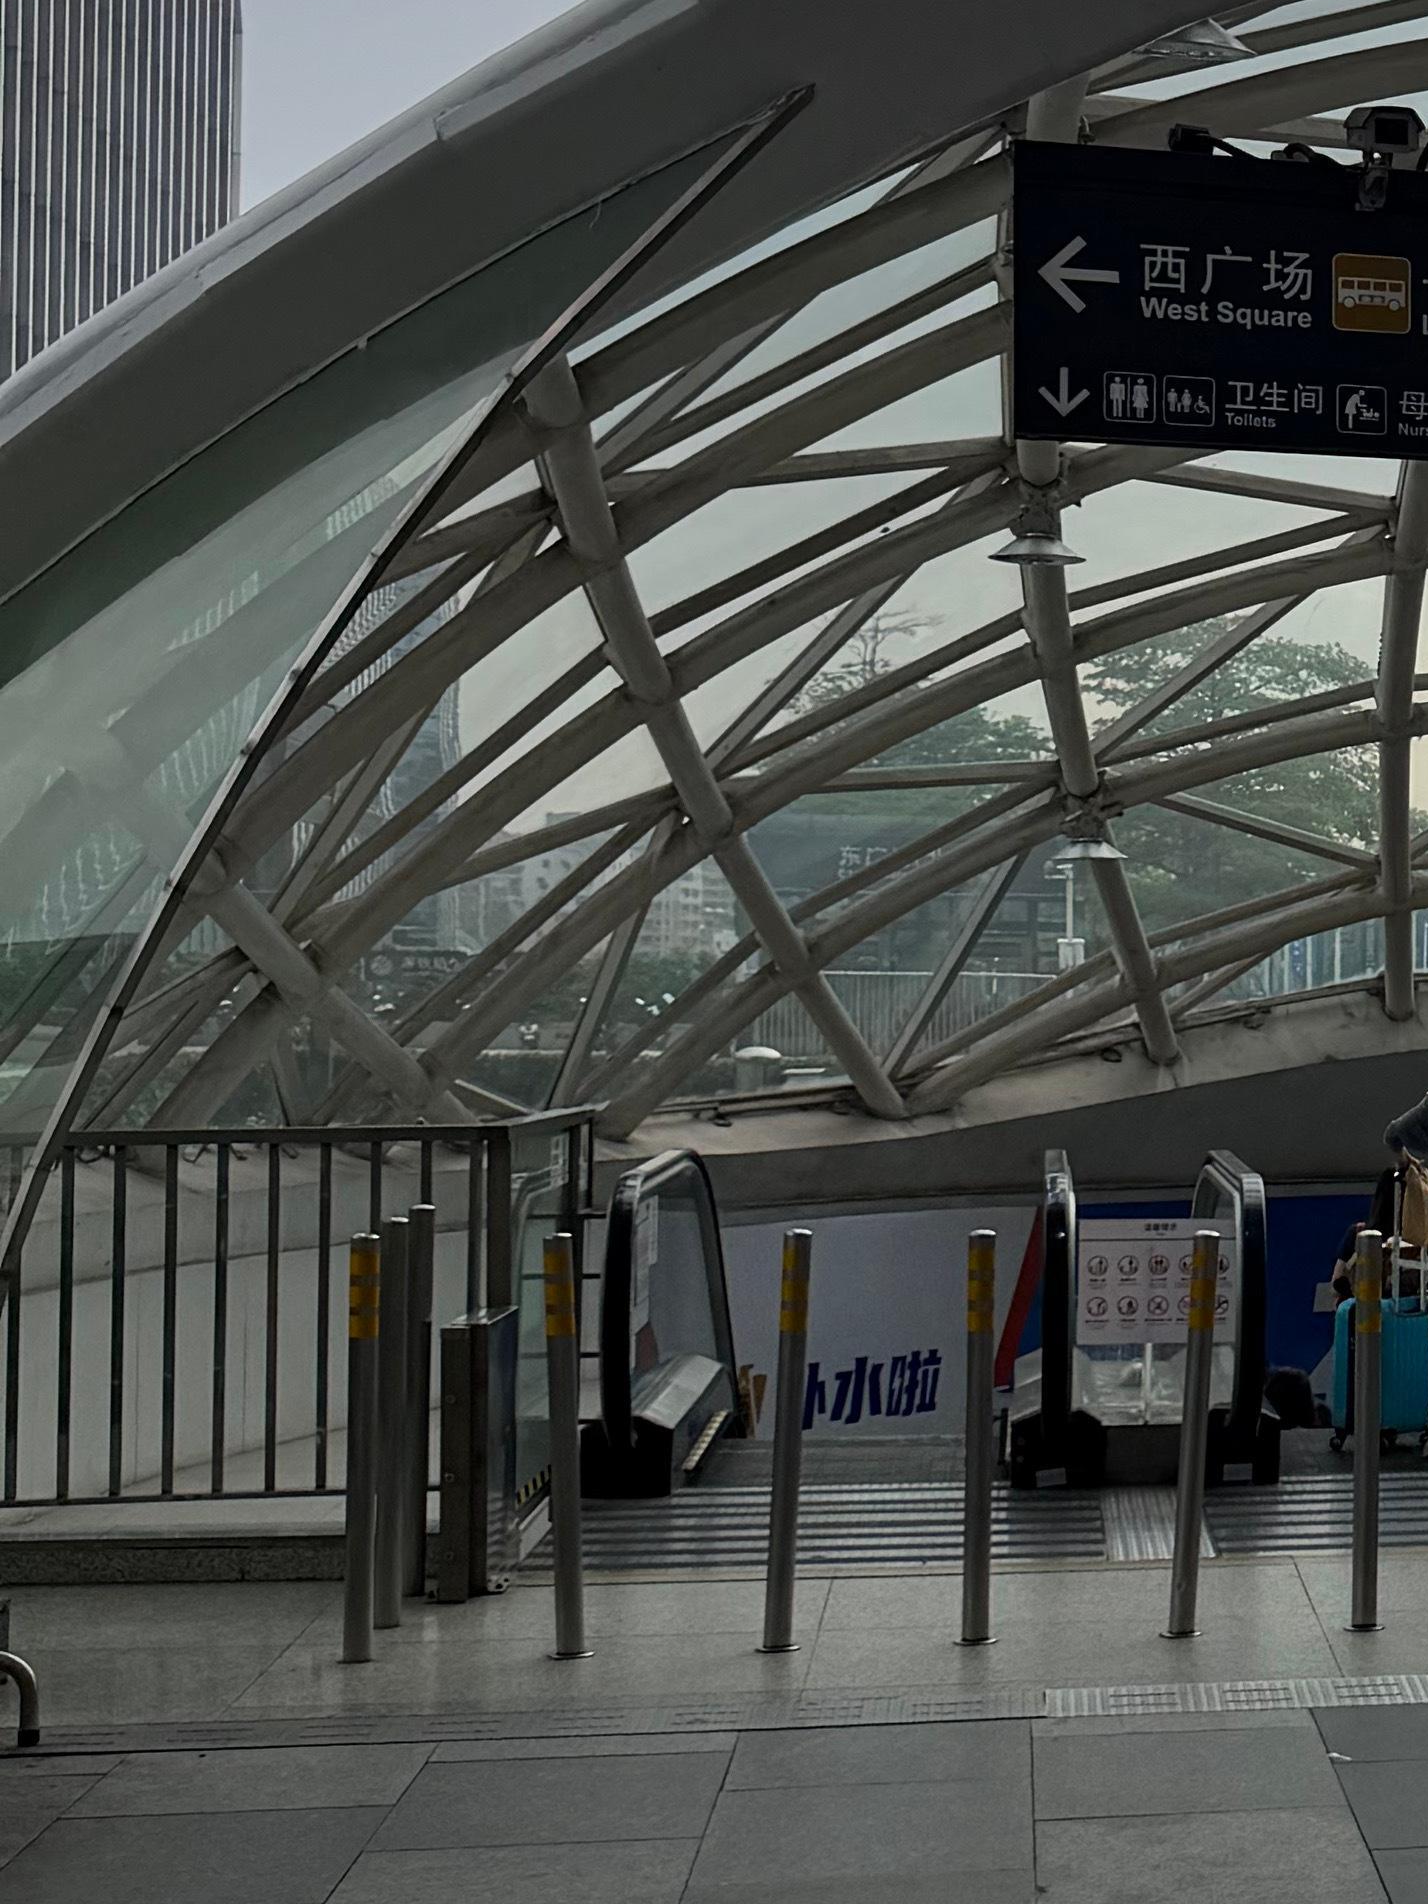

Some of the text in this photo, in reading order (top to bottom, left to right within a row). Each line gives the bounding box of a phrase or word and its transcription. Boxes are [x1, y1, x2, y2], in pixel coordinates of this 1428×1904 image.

[1140, 243, 1313, 301] 西广场
[1140, 297, 1312, 330] West Square
[1225, 380, 1324, 415] 卫生间
[1225, 412, 1277, 429] Toilets
